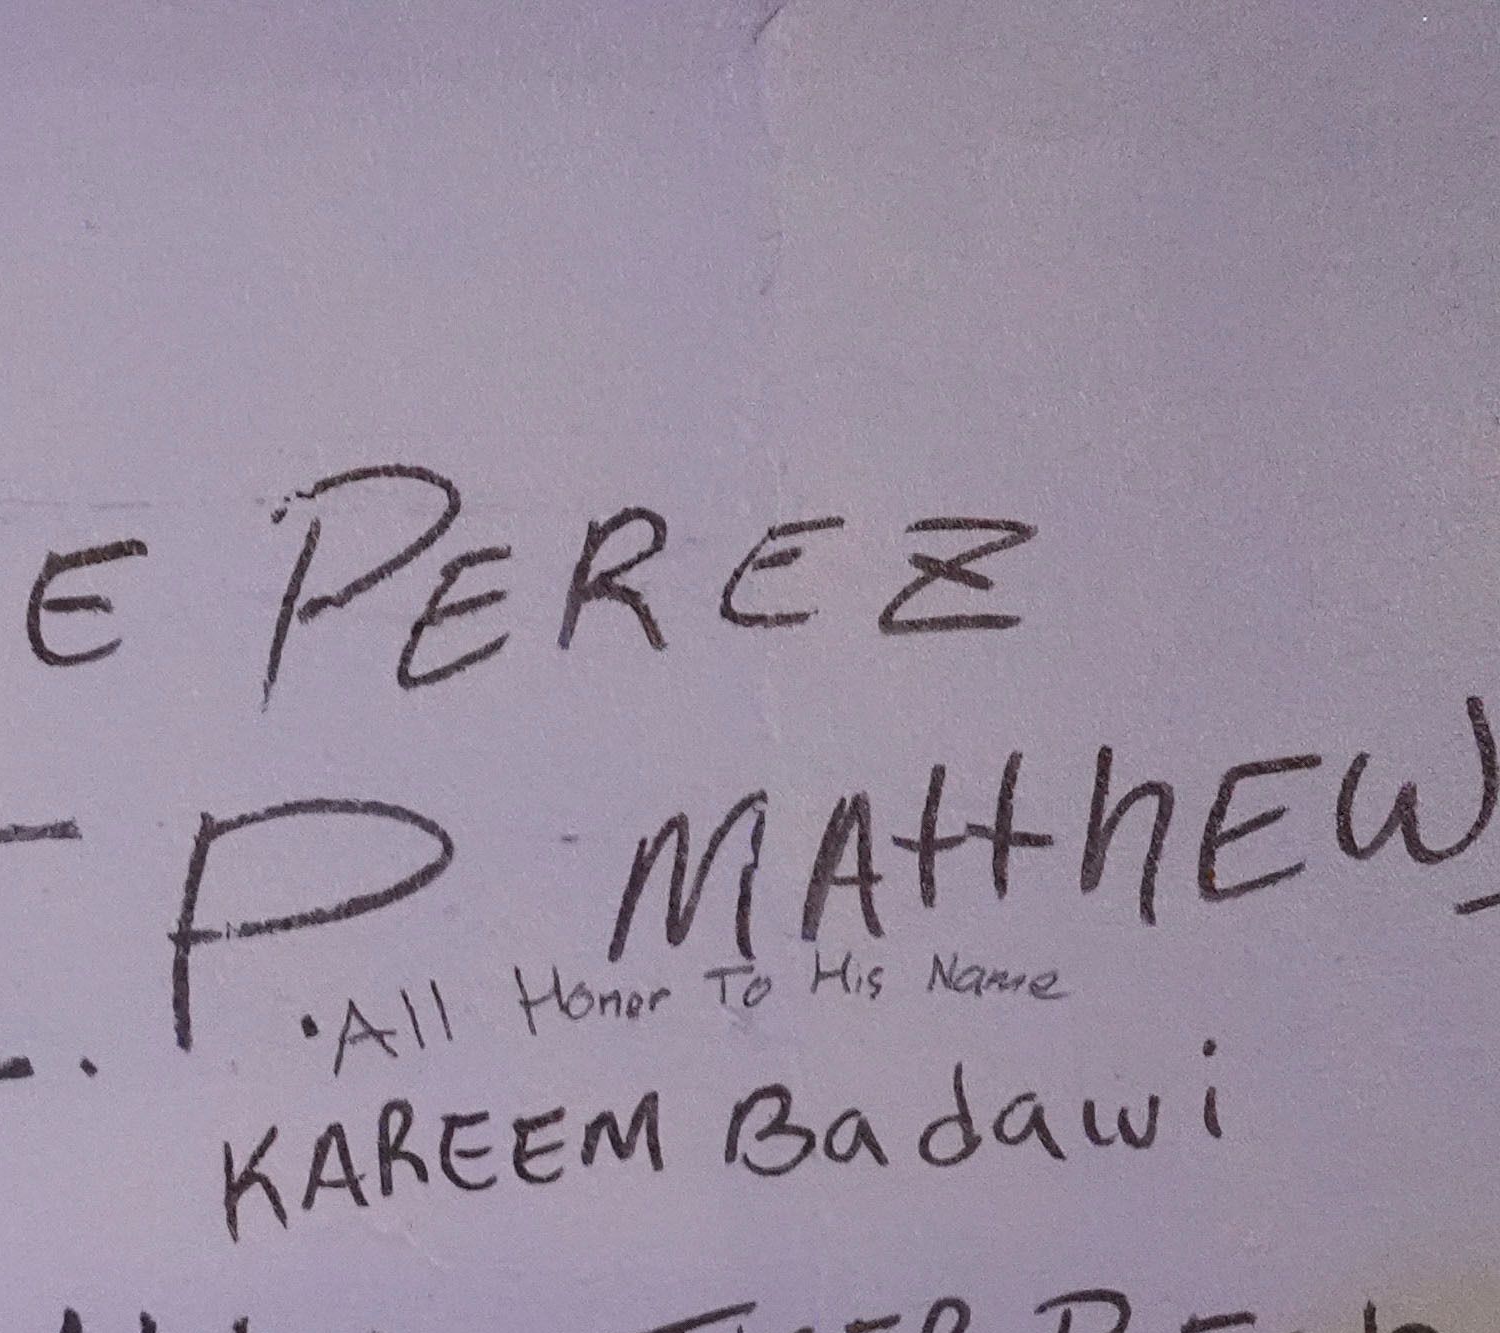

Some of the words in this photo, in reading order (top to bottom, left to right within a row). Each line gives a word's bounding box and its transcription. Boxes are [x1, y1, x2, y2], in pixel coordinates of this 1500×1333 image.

[263, 464, 1038, 710] PEREZ
[222, 1086, 665, 1244] KAREEM
[725, 1038, 1223, 1176] Badawi
